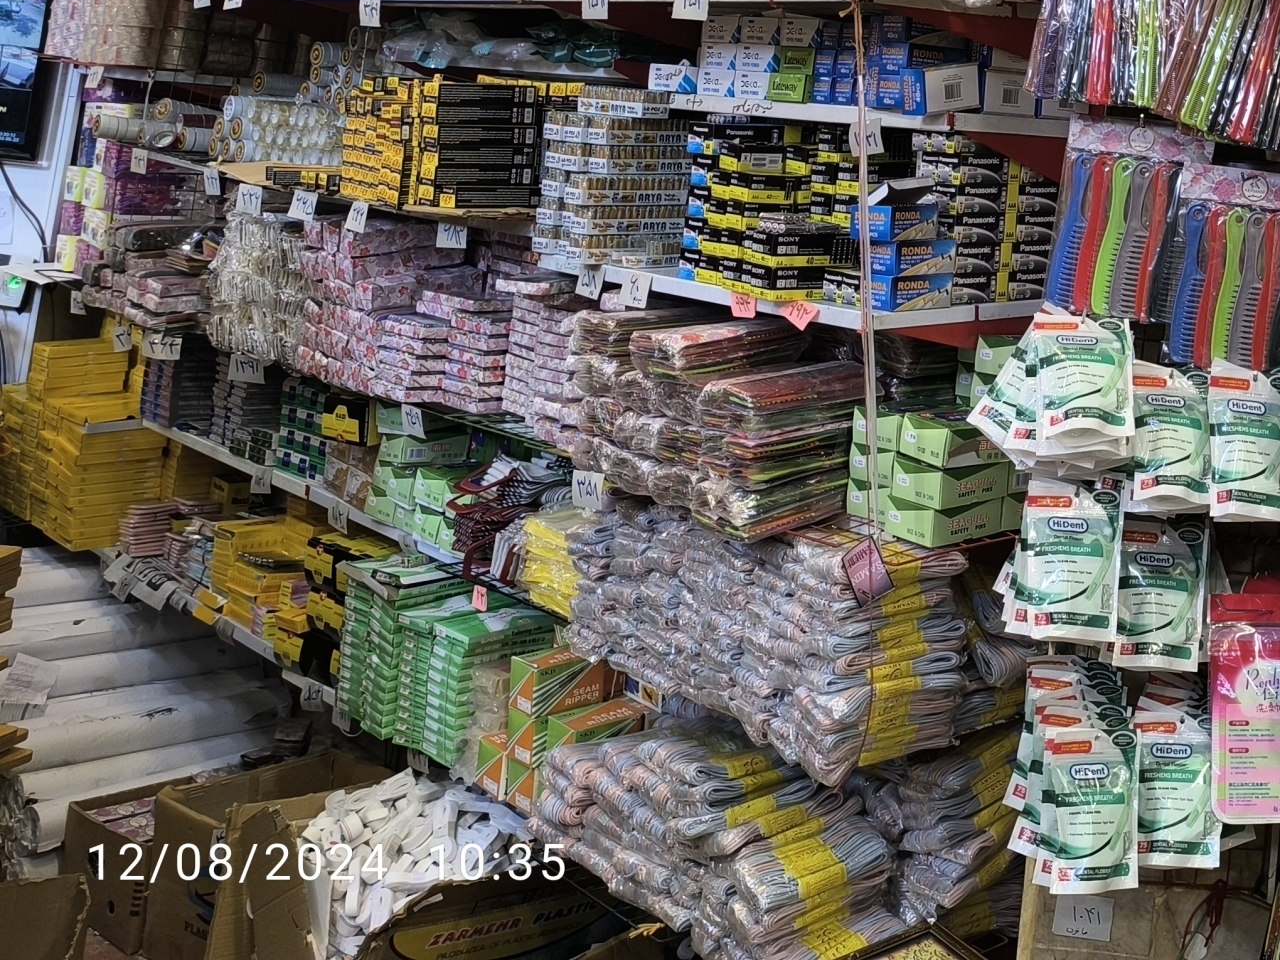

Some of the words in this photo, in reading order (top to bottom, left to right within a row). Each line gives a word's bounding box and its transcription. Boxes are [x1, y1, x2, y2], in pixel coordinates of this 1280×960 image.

[913, 49, 943, 59] RONDA
[785, 52, 808, 66] Liteway
[772, 77, 798, 92] Liteway
[659, 134, 681, 143] ARYA
[660, 162, 682, 170] ARYA
[638, 193, 662, 202] ARYA
[896, 212, 920, 220] RONDA
[643, 222, 666, 230] ARYA
[902, 246, 933, 255] RONDA
[958, 246, 991, 254] Panasonic
[898, 281, 929, 289] RONDA
[1151, 397, 1181, 405] HiDent
[1232, 402, 1262, 412] HiDent
[956, 477, 996, 491] SEAGULL
[948, 513, 990, 529] SEAGULL
[1053, 521, 1084, 529] HiDent
[1140, 556, 1170, 564] HiDent
[540, 669, 555, 677] SKD
[573, 684, 599, 696] SEAM
[565, 690, 599, 705] RIPPER
[580, 730, 595, 738] SKD
[1156, 746, 1188, 755] HiDent
